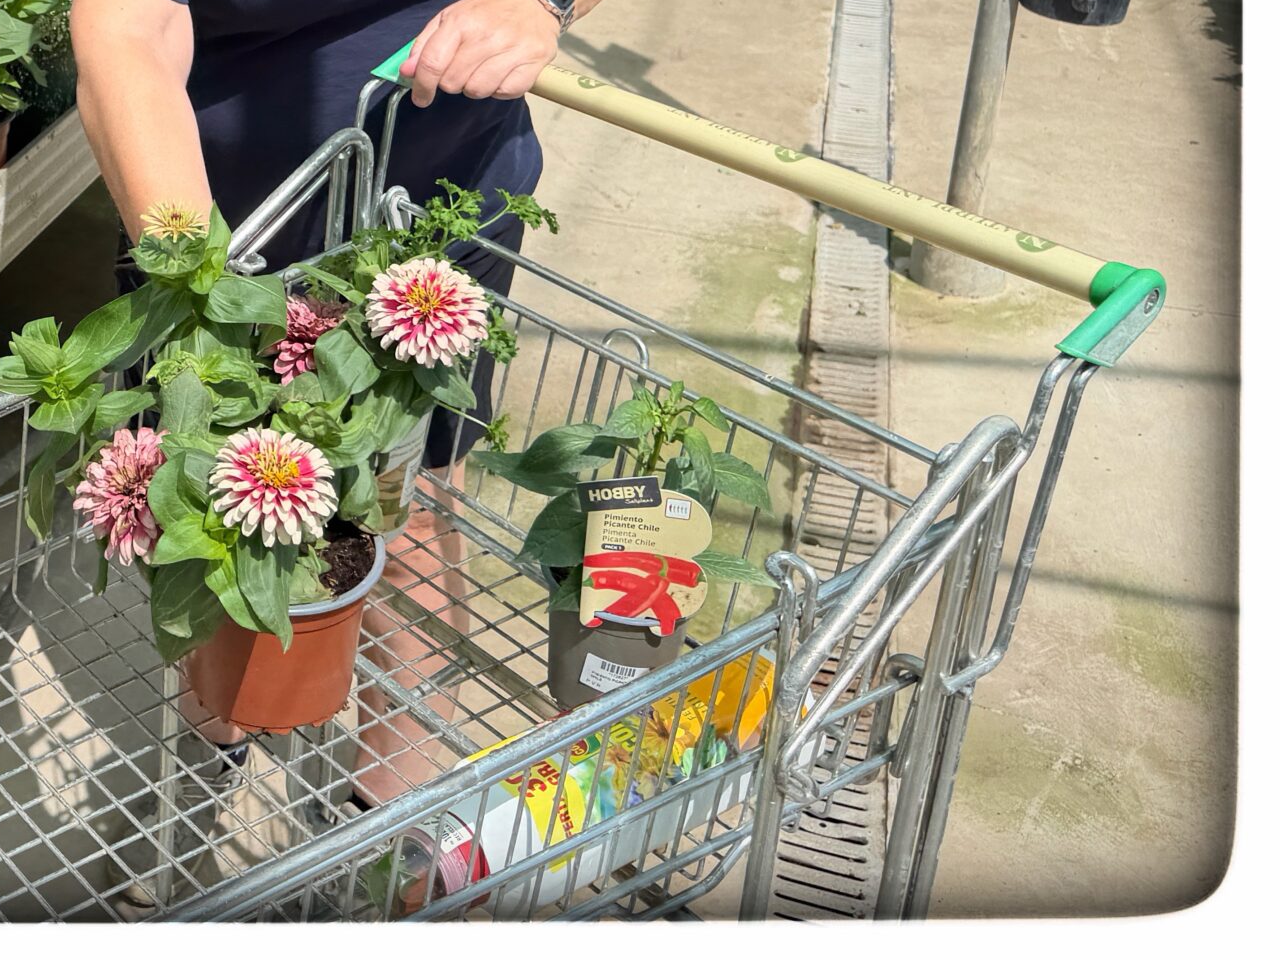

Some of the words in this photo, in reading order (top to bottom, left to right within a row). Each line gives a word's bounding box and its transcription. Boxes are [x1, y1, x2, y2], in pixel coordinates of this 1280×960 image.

[588, 485, 646, 502] HOBBY
[604, 513, 644, 523] Pimiento
[603, 520, 636, 530] Picante
[638, 523, 660, 533] Chile
[602, 528, 637, 538] Pimenta
[602, 535, 633, 545] Picante
[634, 538, 656, 547] Chile
